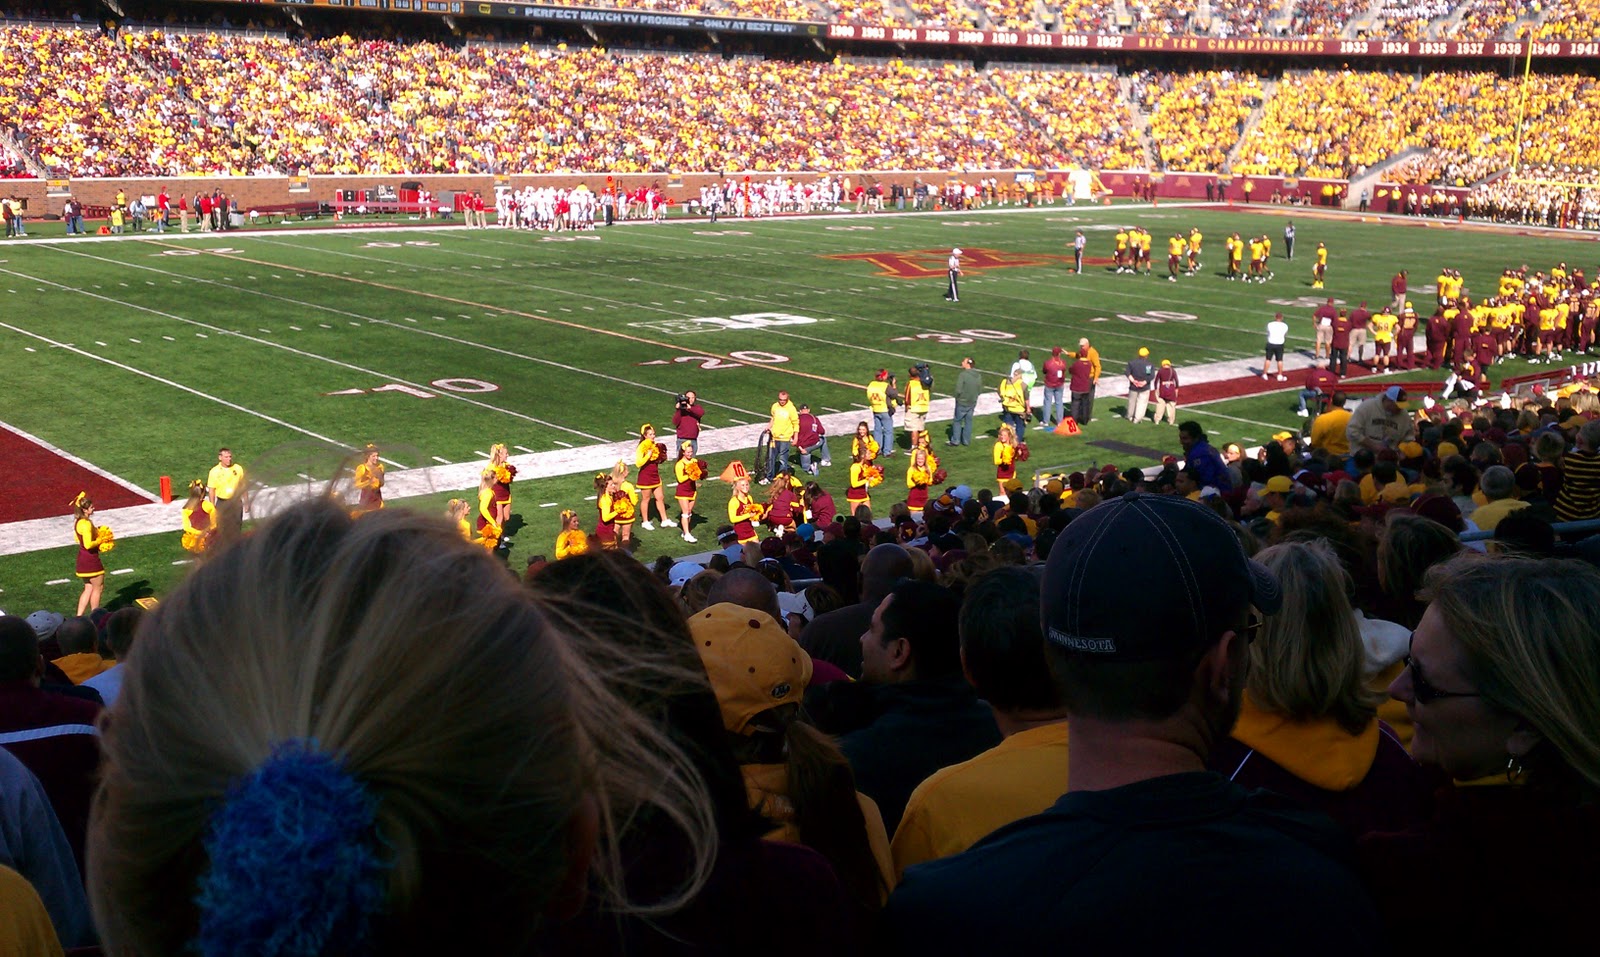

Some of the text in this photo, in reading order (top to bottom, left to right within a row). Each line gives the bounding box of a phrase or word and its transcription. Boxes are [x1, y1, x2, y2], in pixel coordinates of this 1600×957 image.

[525, 7, 579, 19] PERFECT
[580, 11, 621, 21] MATCH
[622, 14, 639, 23] TV
[703, 19, 730, 29] ONLY
[732, 21, 745, 29] AT
[746, 22, 772, 31] BEST
[992, 32, 1018, 44] 1910
[1026, 33, 1052, 45] 1911
[1061, 35, 1088, 46] 1915
[1096, 36, 1124, 47] 1927
[1139, 37, 1164, 49] BIG
[1172, 38, 1198, 49] TEN
[1207, 38, 1325, 52] CHAMPIONSHIPS
[1340, 41, 1368, 53] 1933
[1381, 42, 1410, 54] 1934
[1419, 42, 1447, 54] 1935
[1456, 43, 1485, 54] 1937
[1493, 43, 1522, 55] 1938
[1532, 43, 1560, 55] 1940
[1570, 43, 1599, 55] 1941
[914, 328, 1018, 344] 30
[670, 350, 792, 370] 20
[371, 378, 501, 399] 10
[732, 463, 745, 478] 10
[1048, 629, 1115, 650] MINNESOTA
